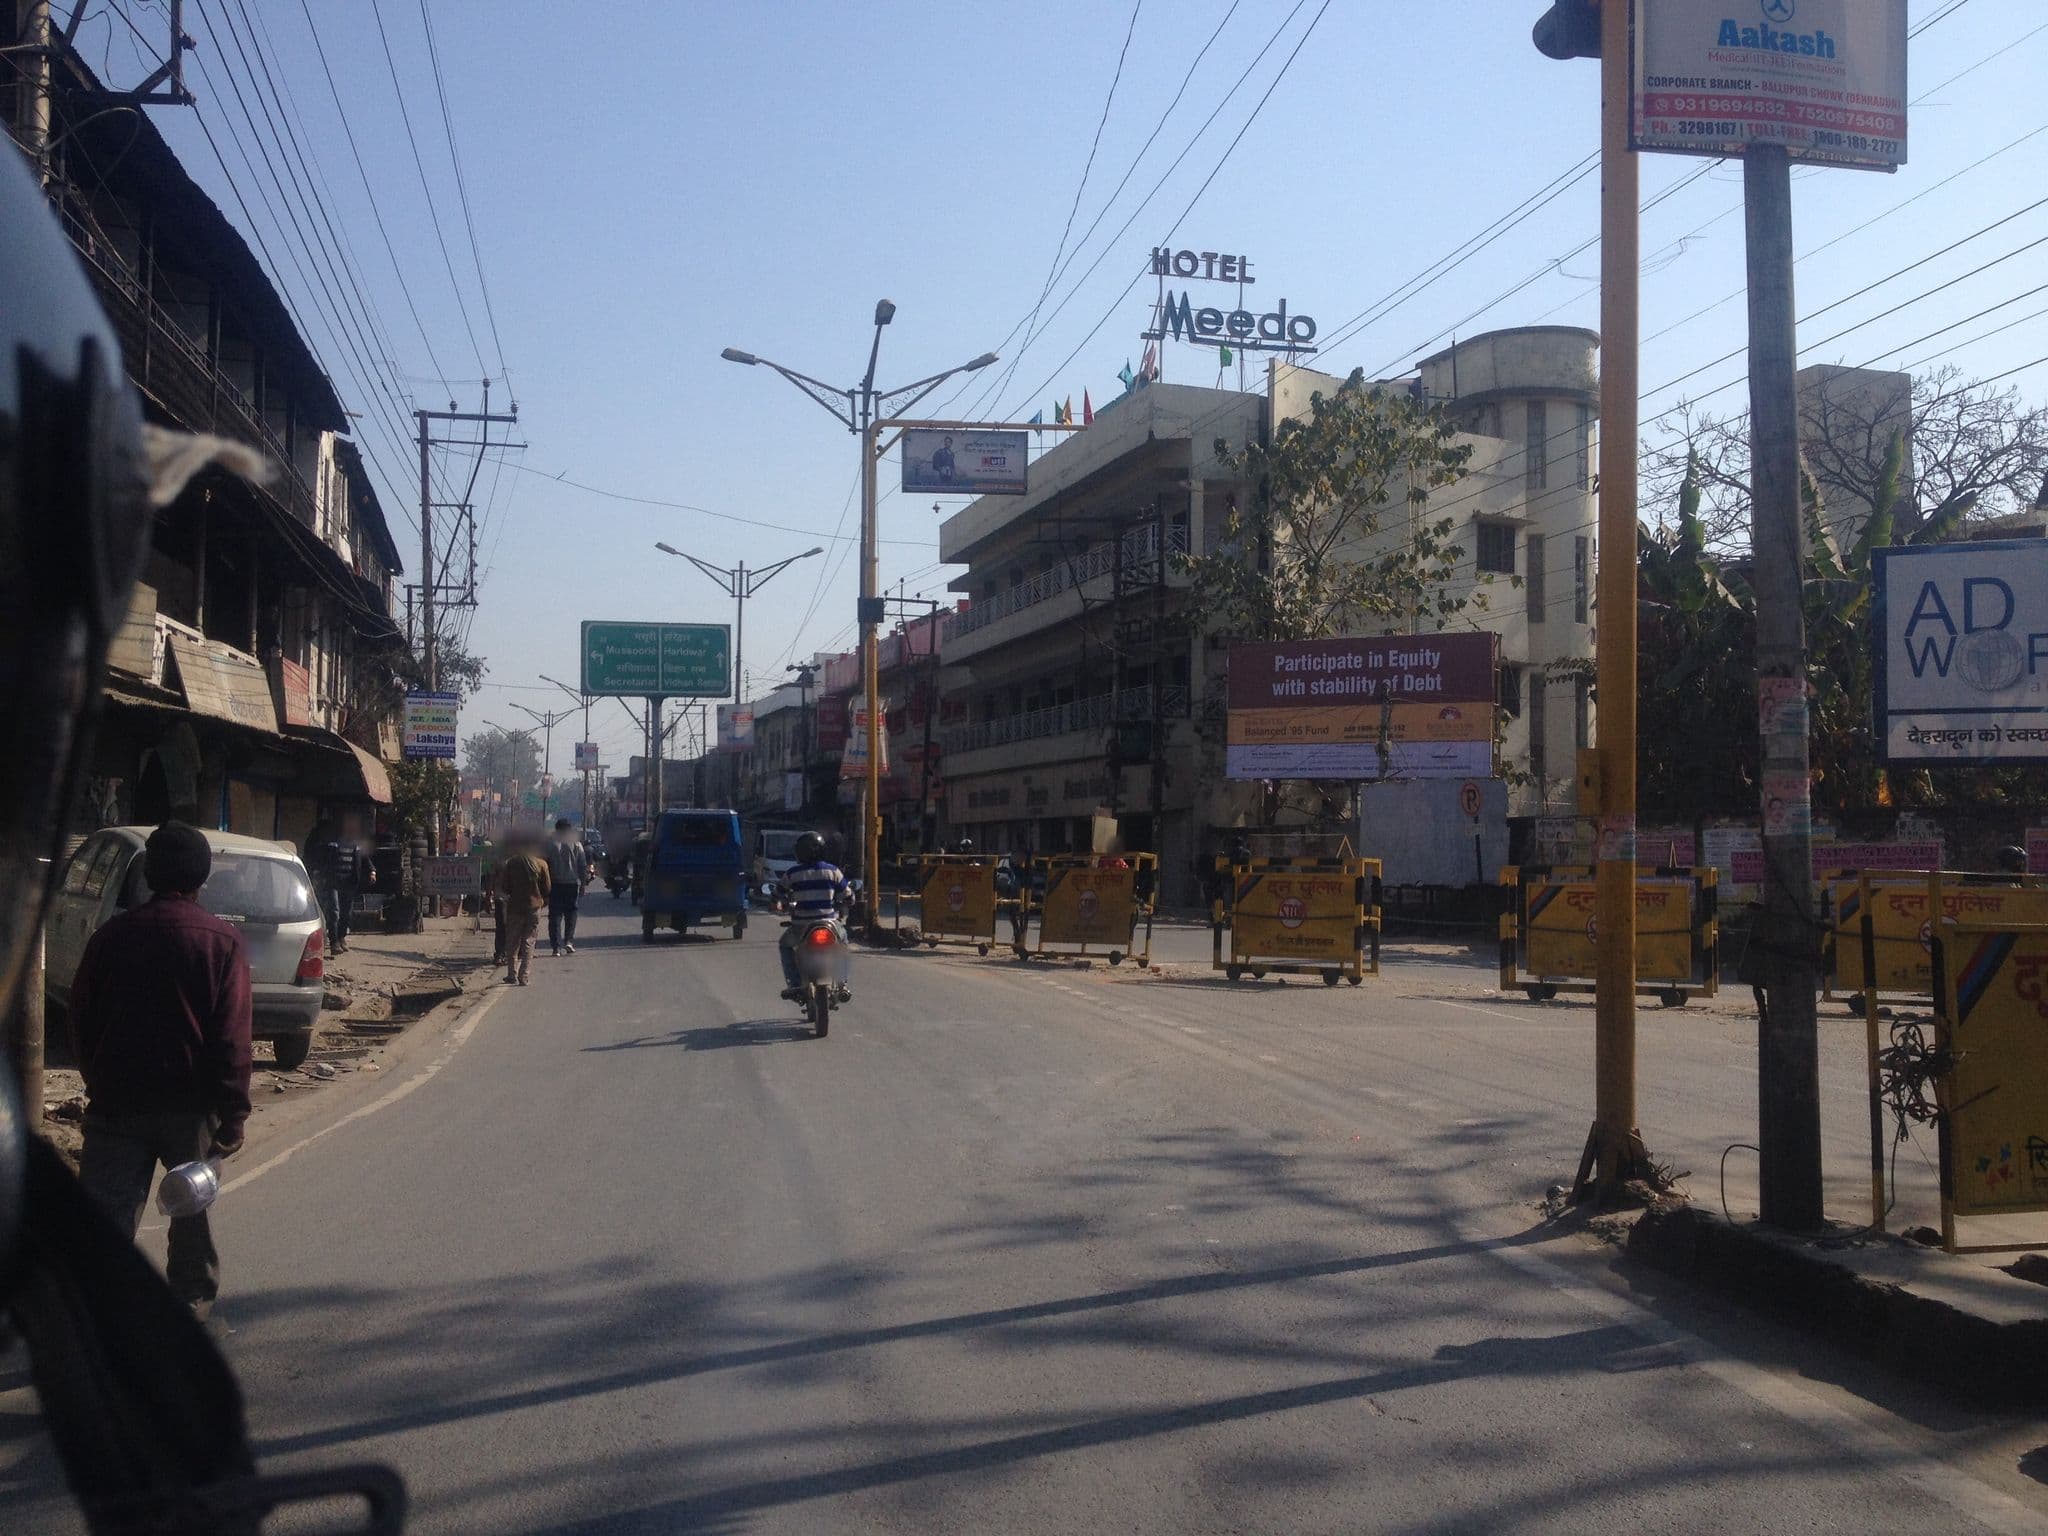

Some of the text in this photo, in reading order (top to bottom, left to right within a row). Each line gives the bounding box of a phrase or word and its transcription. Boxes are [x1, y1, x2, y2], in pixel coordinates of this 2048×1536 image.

[1717, 18, 1836, 58] Aakash
[1647, 76, 1707, 89] CORPORATE
[1709, 78, 1752, 91] BRANCH
[1810, 87, 1843, 102] CHOWK
[1151, 246, 1256, 284] HOTEL
[1161, 289, 1317, 344] Meedo
[1904, 577, 2015, 637] AD
[663, 648, 706, 657] Haridwar
[1274, 648, 1441, 673] Participate in Equity
[1272, 678, 1306, 696] with
[1310, 675, 1377, 696] stability
[1404, 673, 1442, 692] Debt
[1244, 725, 1287, 737] Balanced
[1305, 725, 1330, 736] Fund
[1907, 725, 1973, 750] देहरादून
[1978, 724, 2001, 743] को
